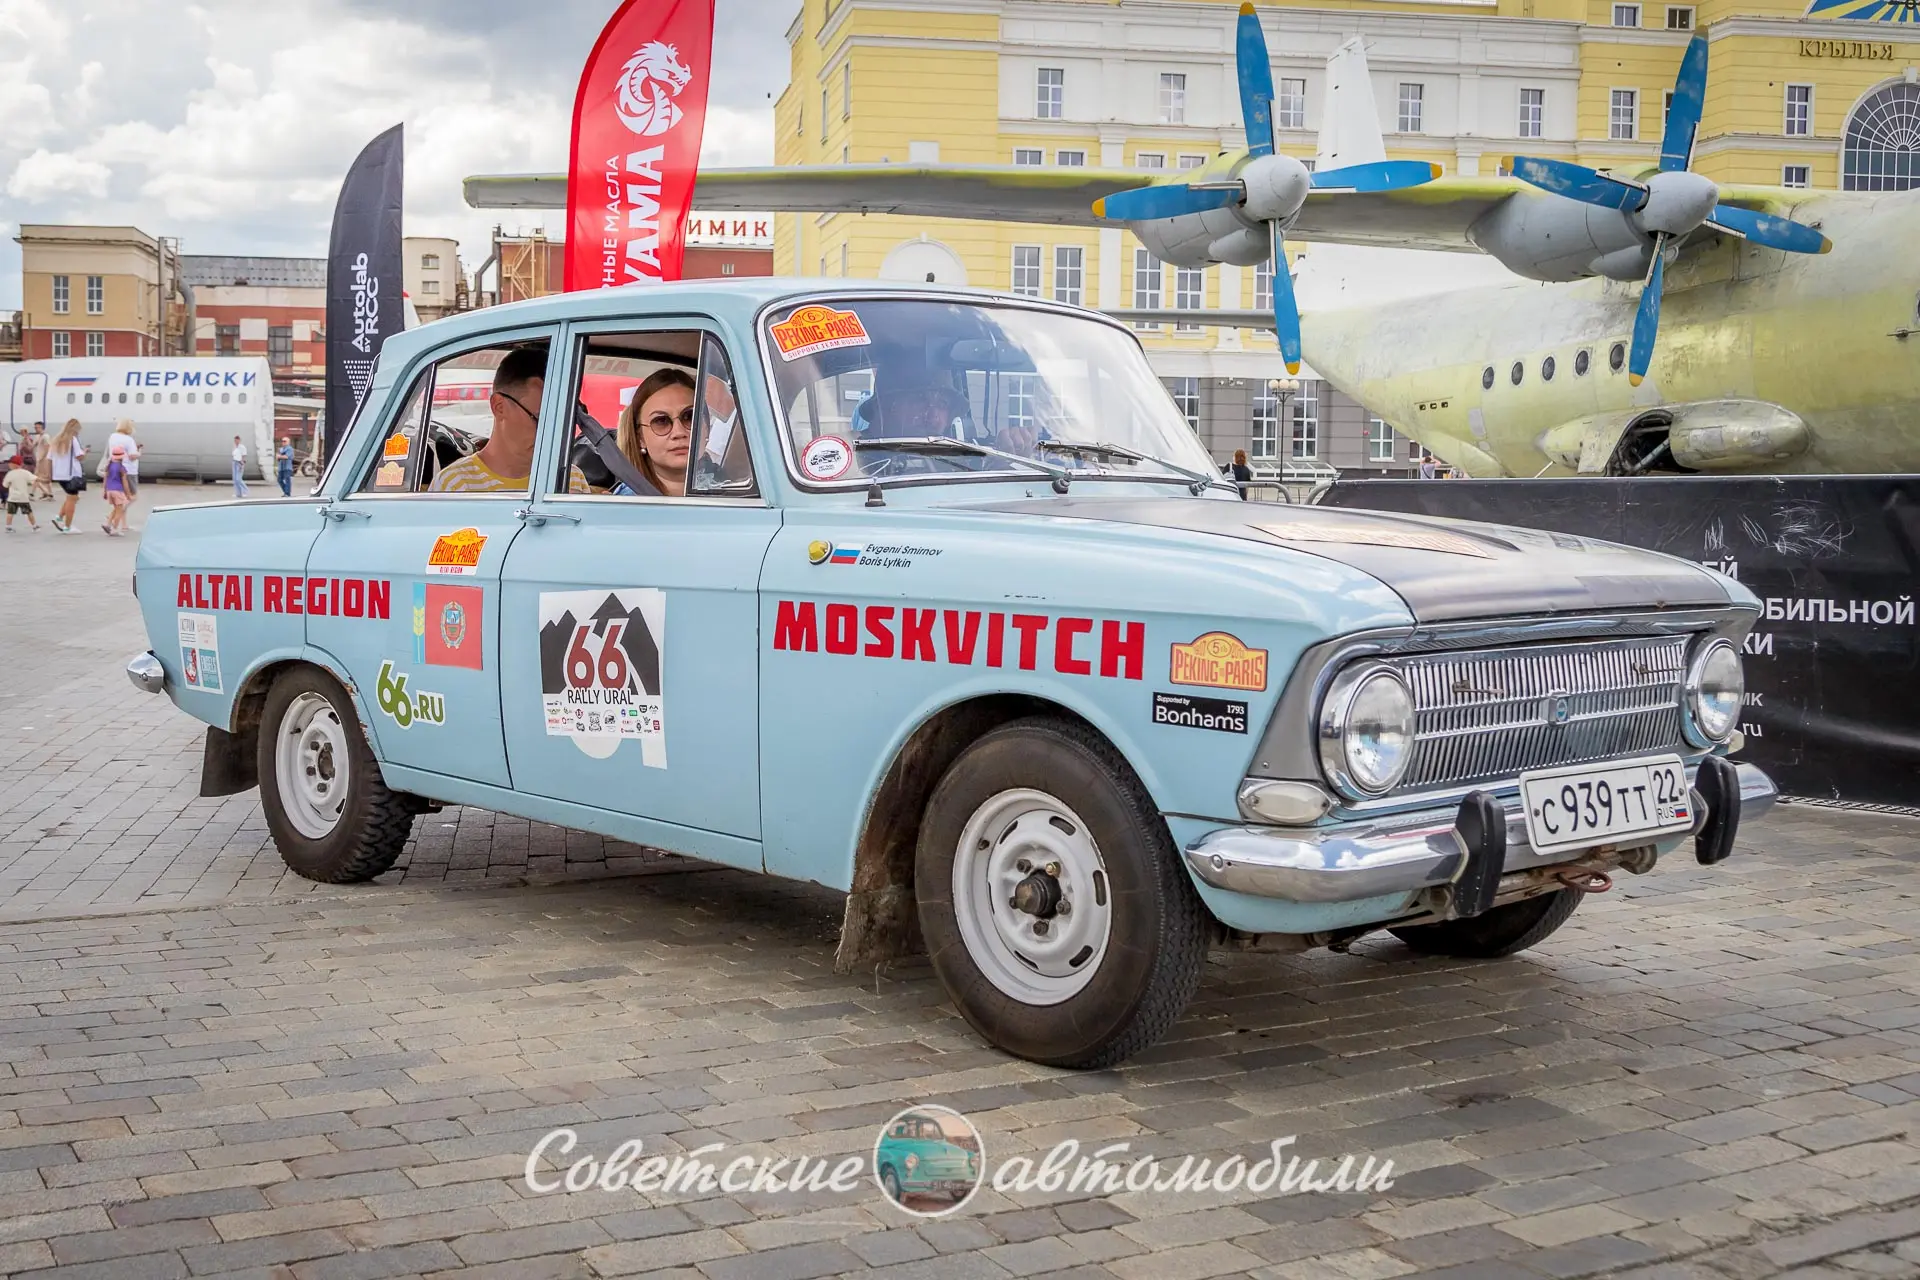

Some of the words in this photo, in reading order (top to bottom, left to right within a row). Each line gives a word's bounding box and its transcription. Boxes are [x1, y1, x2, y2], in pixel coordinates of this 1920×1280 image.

[1799, 40, 1894, 60] КРЫЛЬЯ
[604, 155, 621, 232] МАСЛА
[688, 219, 768, 237] ИМИК
[601, 239, 618, 289] НЫЕ
[350, 252, 369, 353] Autolab
[364, 276, 380, 335] RCC
[364, 337, 372, 353] BY
[776, 324, 824, 350] PEKING
[825, 315, 861, 337] PARIS
[787, 344, 820, 359] SUPPORT
[820, 340, 841, 350] TEAM
[841, 337, 867, 346] RUSSIA
[125, 371, 257, 387] ПЕРМСКИ
[431, 538, 458, 563] PEKING
[859, 556, 881, 567] Boris
[883, 557, 911, 568] Lytkin
[866, 543, 901, 554] Evgenii
[902, 545, 943, 556] Smirnov
[177, 573, 253, 611] ALTAI
[263, 575, 391, 620] REGION
[773, 600, 1145, 680] MOSKVITCH
[567, 624, 627, 691] 66
[1174, 648, 1219, 682] PEKING
[1225, 655, 1263, 687] PARIS
[377, 663, 444, 727] 66.RU
[568, 689, 600, 705] RALLY
[603, 689, 634, 705] URAL
[1156, 694, 1183, 704] Supported
[1183, 697, 1191, 706] by
[1155, 705, 1245, 731] Bonhams
[1227, 704, 1245, 715] 1793
[1653, 768, 1680, 804] 22
[1657, 805, 1675, 820] RUS
